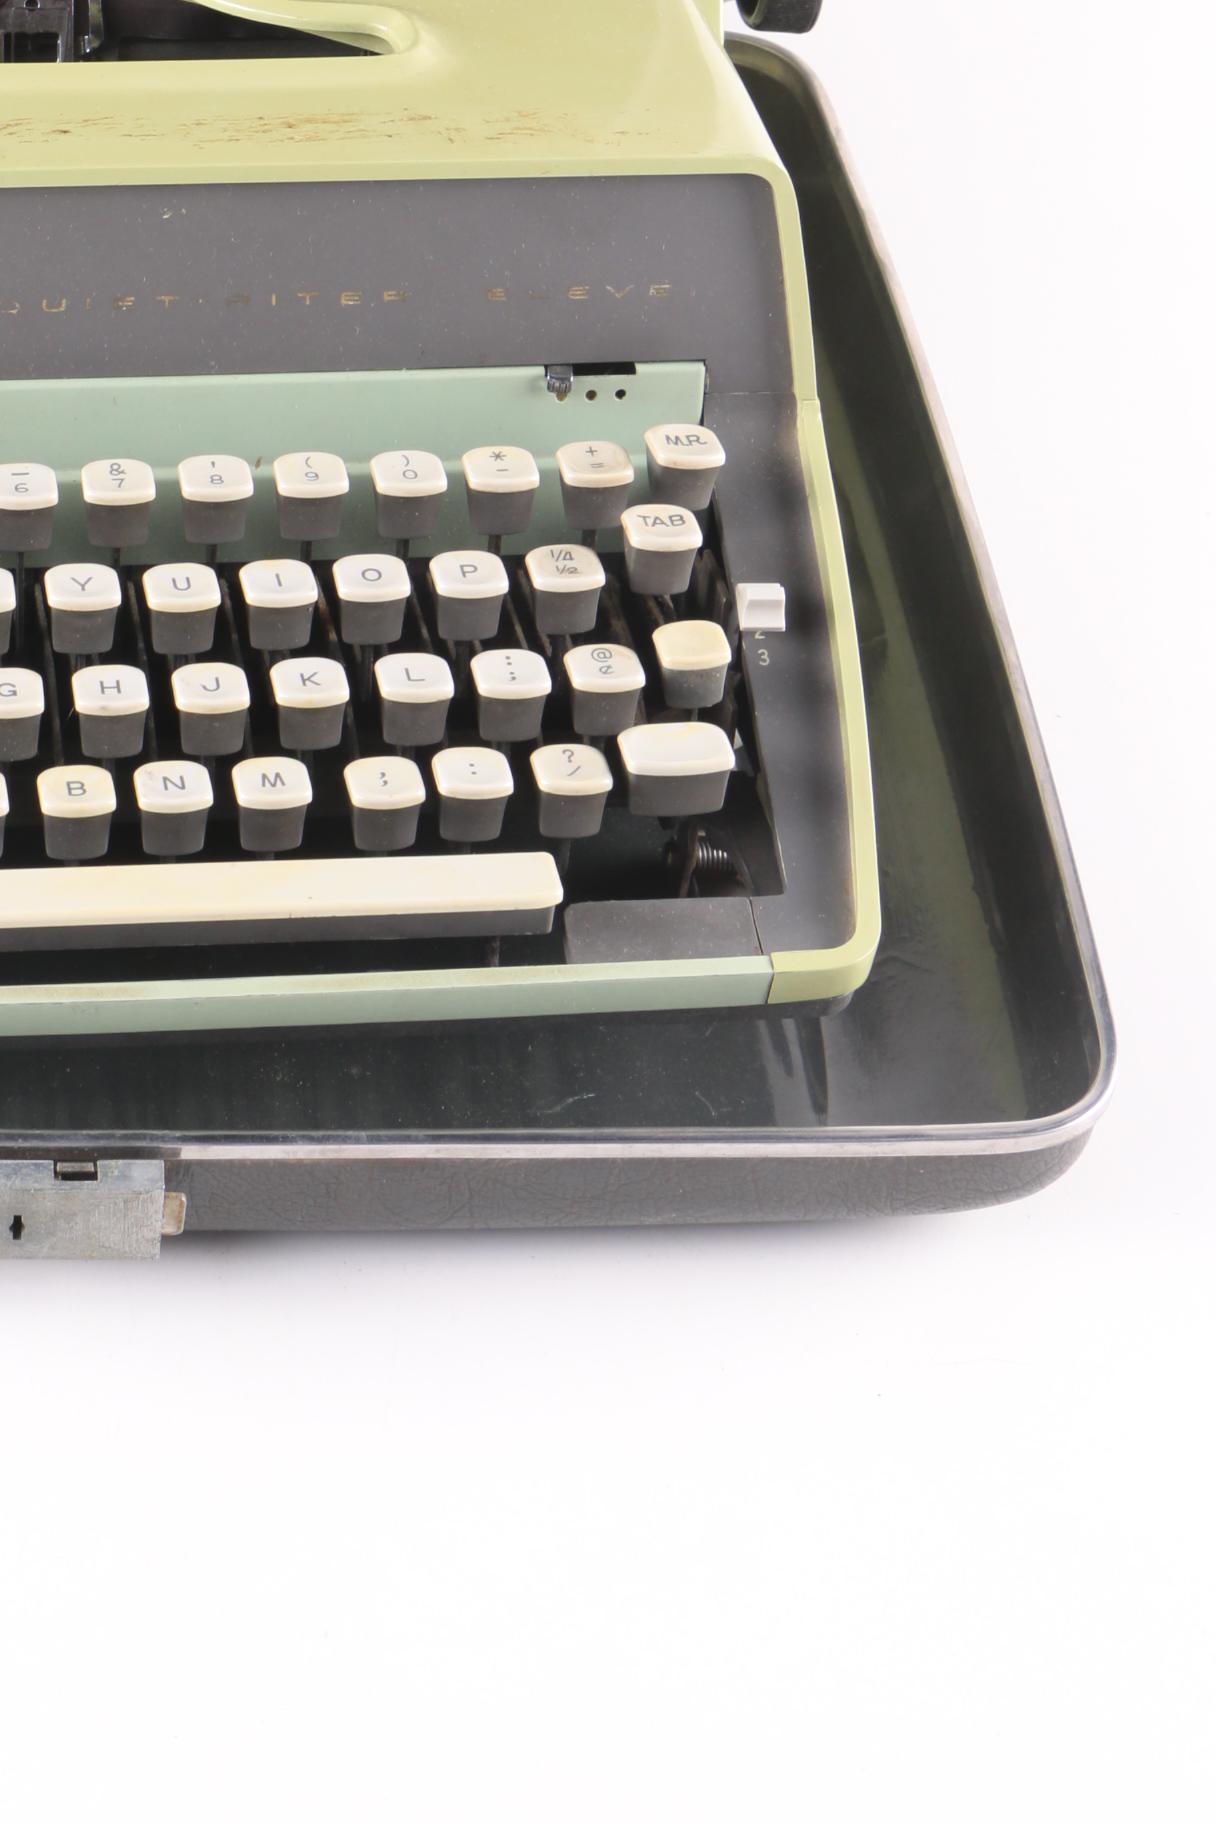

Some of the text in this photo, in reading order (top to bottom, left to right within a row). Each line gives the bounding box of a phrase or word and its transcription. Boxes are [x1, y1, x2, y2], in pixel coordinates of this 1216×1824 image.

[586, 446, 597, 456] +
[305, 457, 312, 469] (
[402, 455, 409, 467] )
[109, 463, 126, 476] &
[112, 478, 124, 488] 7
[210, 474, 224, 484] 8
[305, 472, 319, 481] 9
[14, 483, 29, 493] 6
[638, 514, 686, 527] TAB
[362, 568, 382, 581] O
[460, 565, 477, 578] P
[71, 577, 92, 591] Y
[172, 577, 191, 591] U
[276, 574, 282, 587] I
[591, 648, 612, 662] @
[758, 649, 769, 665] 3
[300, 672, 320, 686] K
[405, 668, 425, 681] L
[100, 680, 121, 694] H
[202, 677, 220, 692] J
[562, 749, 574, 763] ?
[568, 766, 581, 776] /
[163, 776, 185, 790] N
[262, 772, 285, 787] M
[66, 781, 86, 796] B
